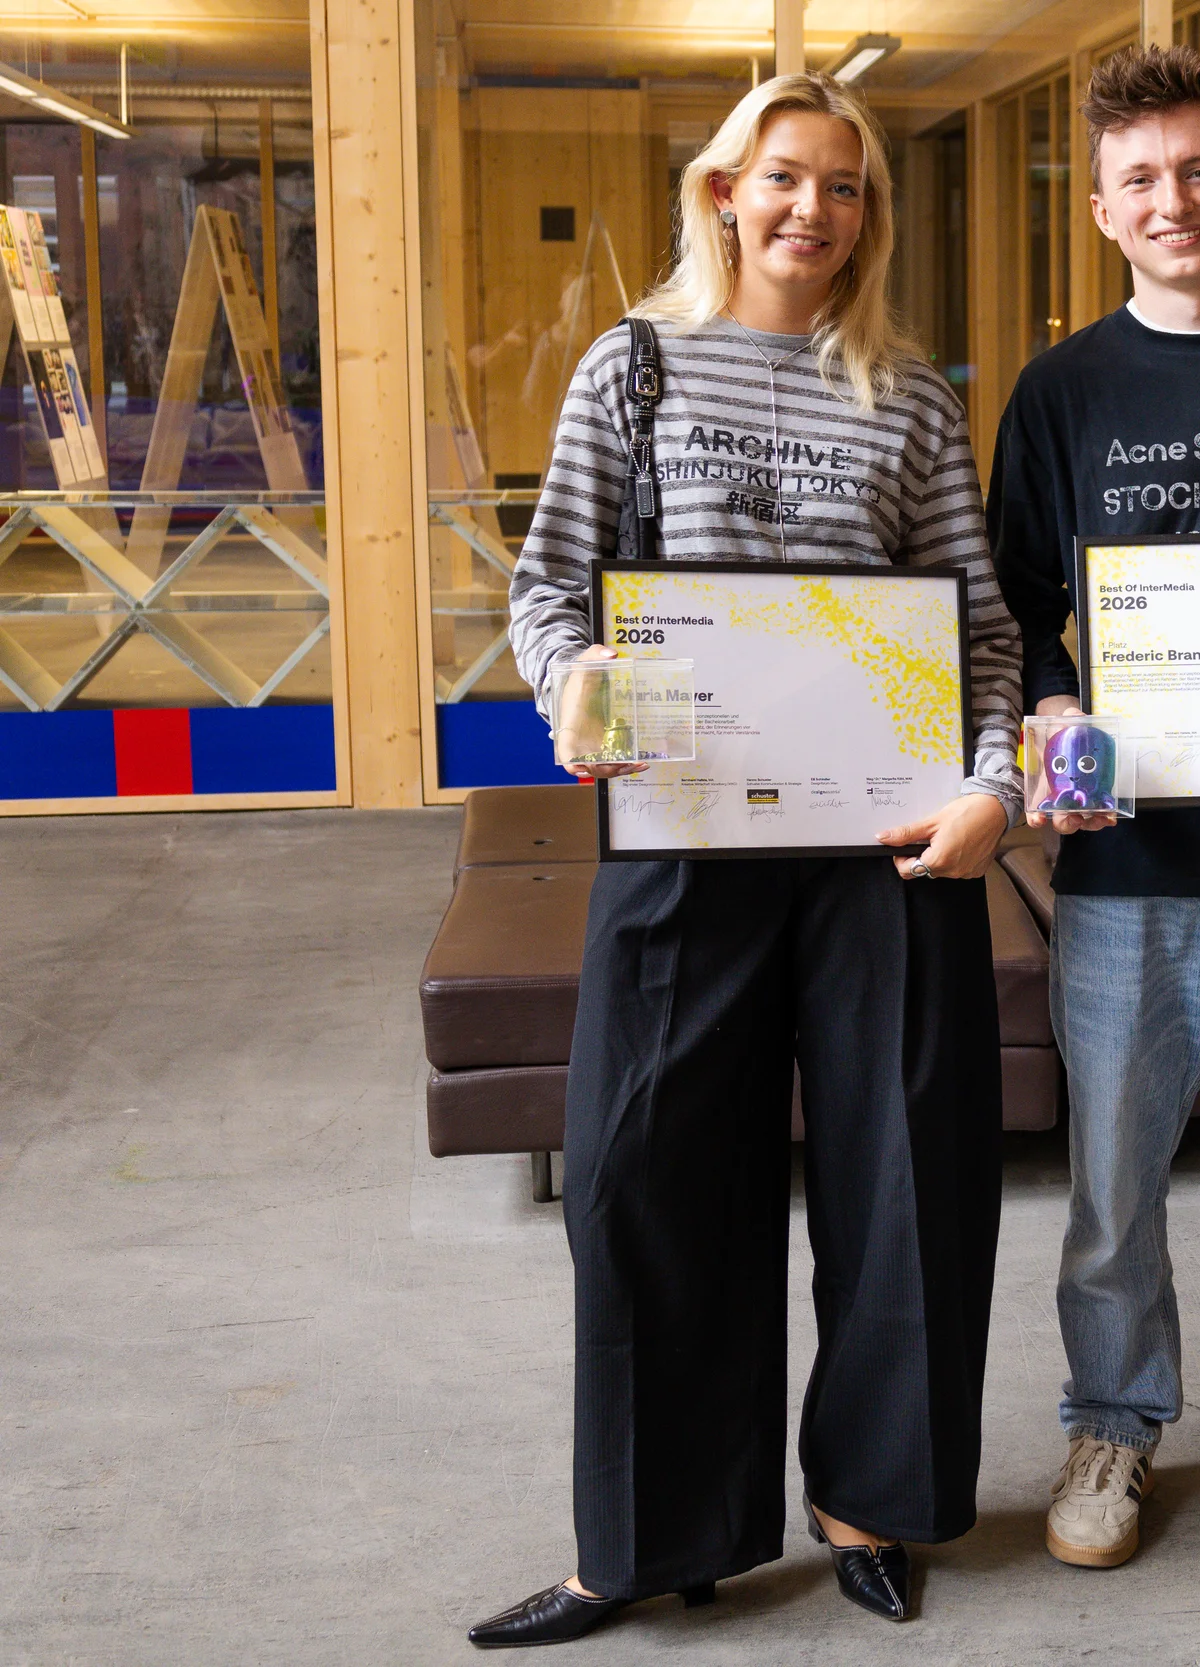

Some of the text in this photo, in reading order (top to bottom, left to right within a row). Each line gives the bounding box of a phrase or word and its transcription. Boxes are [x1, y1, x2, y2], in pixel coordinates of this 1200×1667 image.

[684, 425, 851, 471] ARCHIVE
[1105, 438, 1188, 467] Acne
[655, 459, 881, 504] SHINJUKU TOKYO
[725, 490, 803, 526] 新宿区
[1099, 583, 1195, 593] Best Of InterMedia
[1099, 596, 1148, 611] 2026
[615, 615, 714, 626] Best Of InterMedia
[615, 628, 665, 645] 2026
[1102, 650, 1164, 663] Frederic
[614, 688, 714, 703] Maria Mayer
